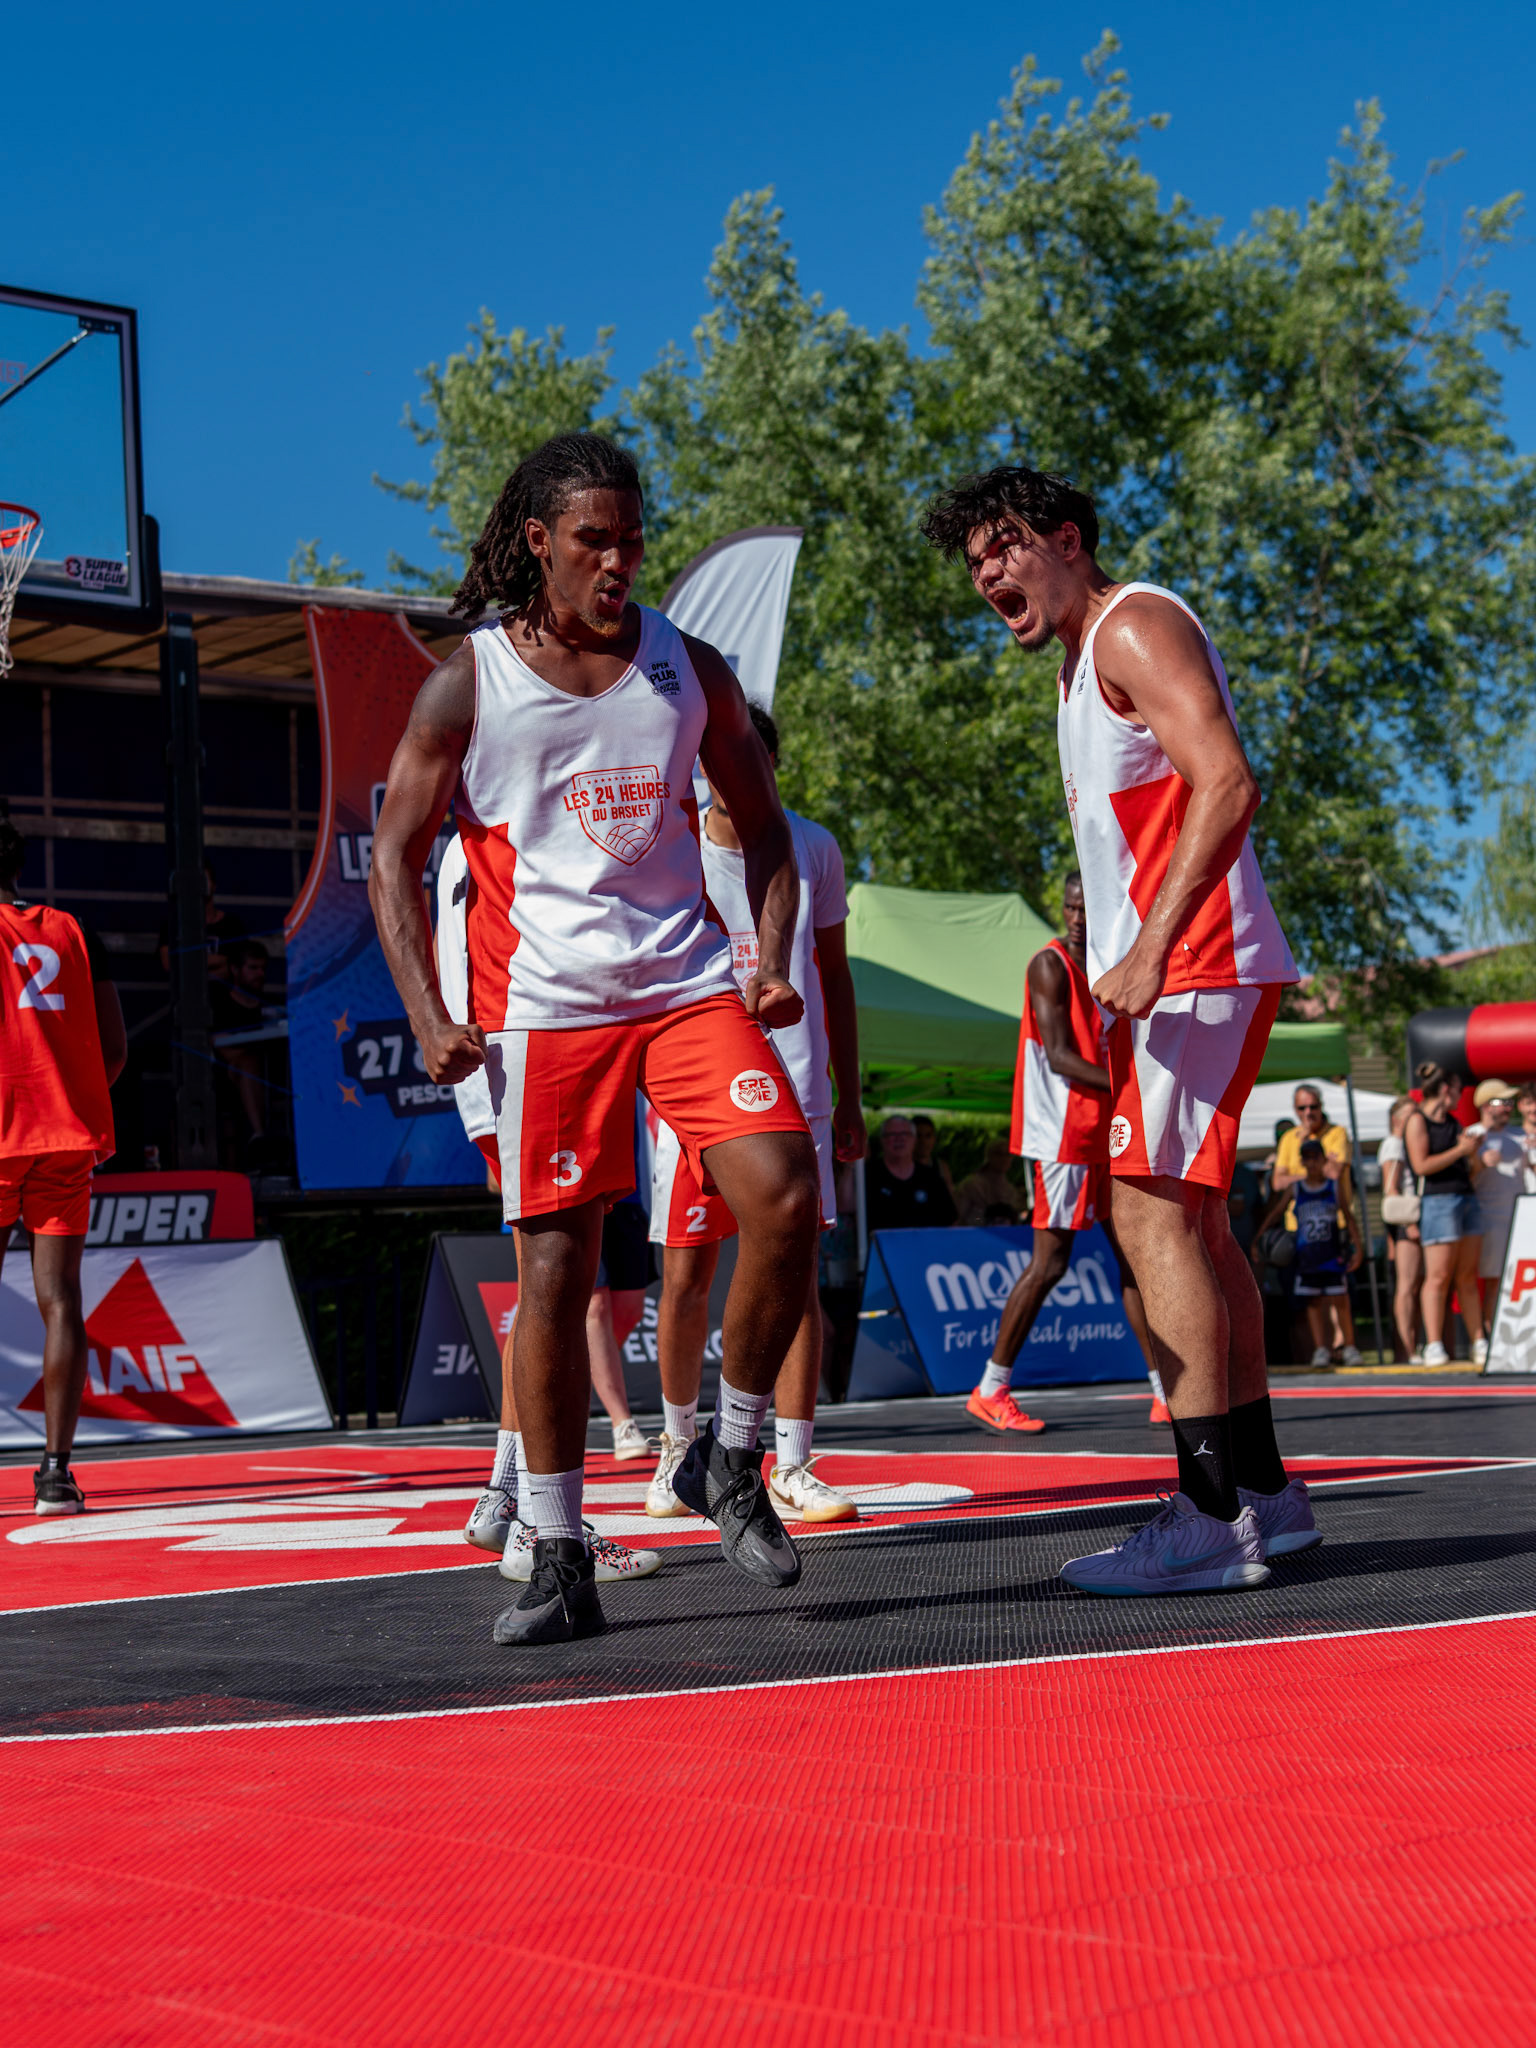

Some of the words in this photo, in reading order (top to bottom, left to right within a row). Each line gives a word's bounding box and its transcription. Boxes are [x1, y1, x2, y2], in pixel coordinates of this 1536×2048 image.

[83, 570, 126, 584] LEAGUE
[86, 559, 122, 571] SUPER
[649, 669, 677, 686] PLUS
[651, 661, 669, 671] OPEN
[563, 789, 591, 812] LES
[595, 785, 616, 806] 24
[619, 781, 671, 803] HEURES
[592, 806, 608, 822] DU
[611, 803, 652, 820] BASKET
[737, 943, 751, 957] 24
[734, 959, 745, 969] DU
[13, 943, 65, 1011] 2
[357, 1035, 404, 1080] 27
[548, 1150, 583, 1187] 3
[86, 1193, 211, 1246] UPER
[686, 1206, 708, 1233] 2
[1306, 1218, 1331, 1241] 23
[925, 1250, 1115, 1312] molen
[943, 1321, 977, 1352] For
[980, 1318, 1000, 1348] th
[1029, 1315, 1064, 1343] eal
[1066, 1320, 1126, 1353] game
